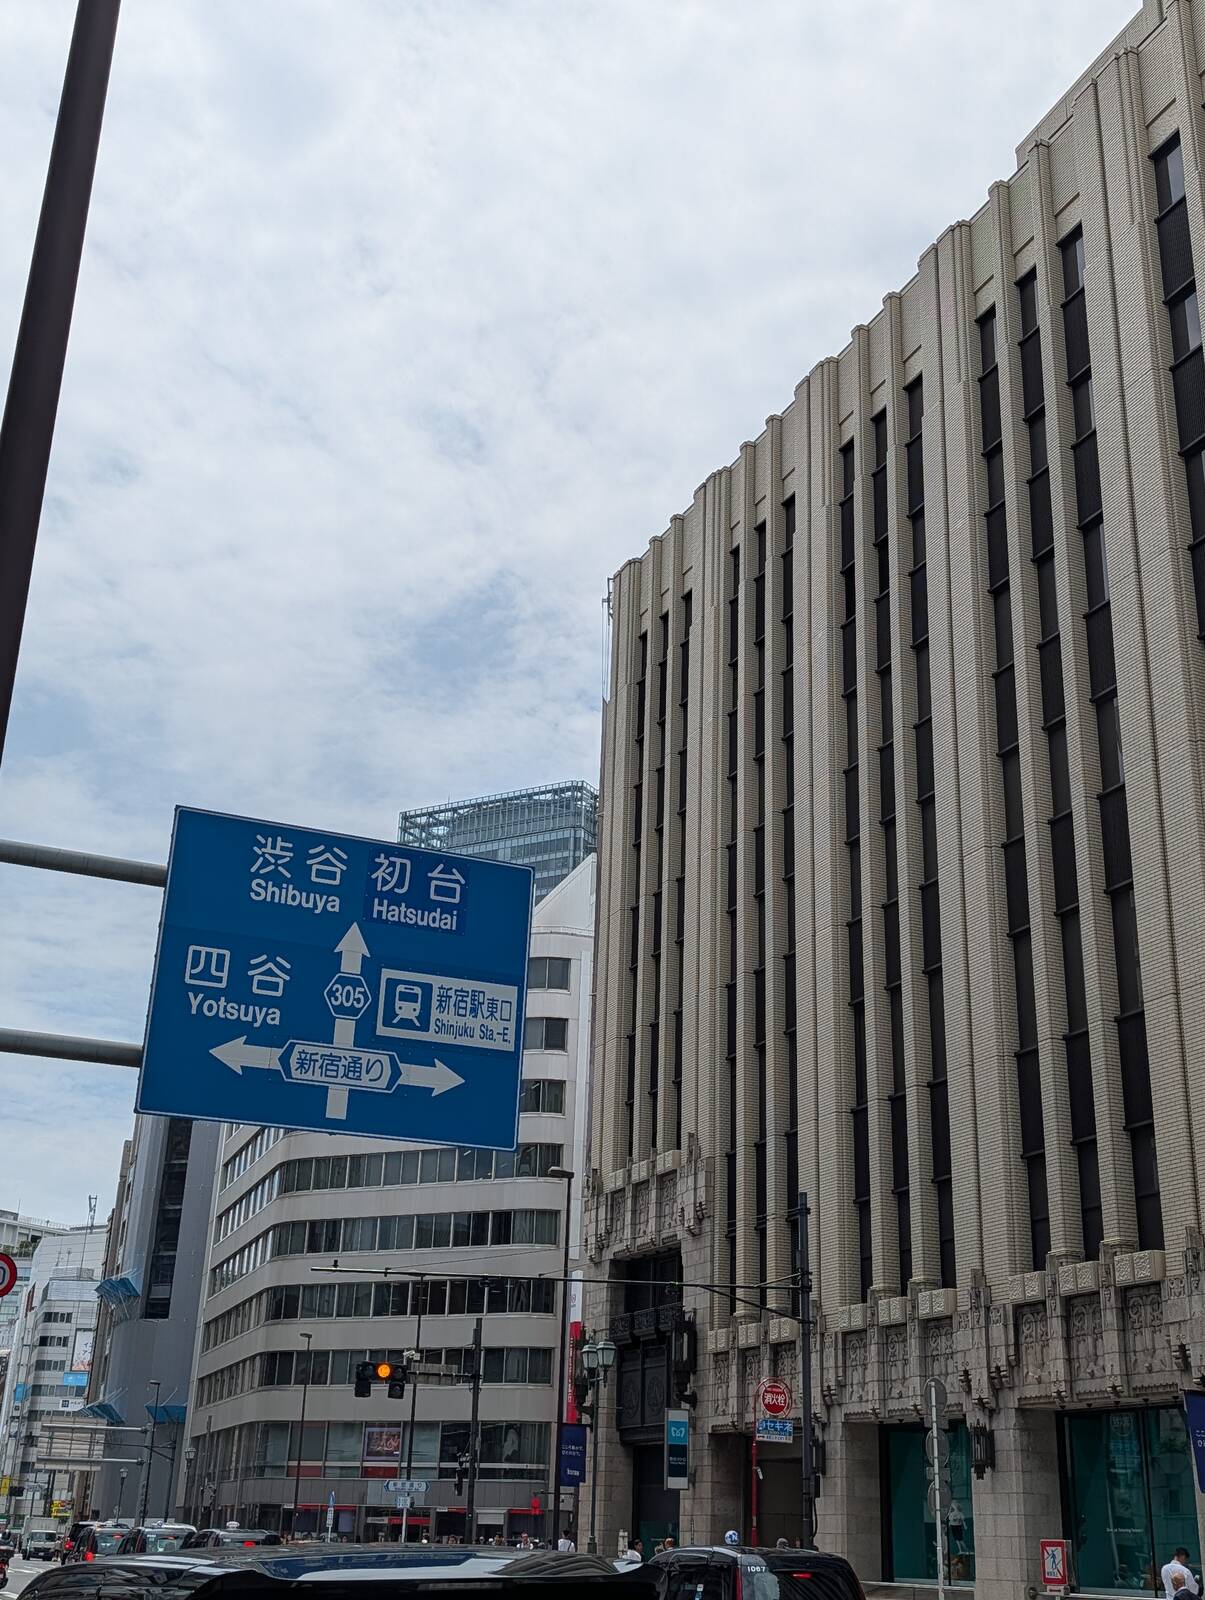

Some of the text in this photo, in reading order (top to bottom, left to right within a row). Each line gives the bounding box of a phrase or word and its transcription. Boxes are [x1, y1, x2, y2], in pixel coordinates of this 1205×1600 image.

[250, 834, 348, 886] 渋谷
[249, 878, 341, 914] Shibuya
[371, 853, 466, 904] 初台
[372, 897, 458, 931] Hatsudai
[184, 944, 292, 997] 四谷
[187, 991, 281, 1028] Yotsuya
[330, 983, 365, 1009] 305
[435, 984, 513, 1022] 新宿駅東口
[434, 1017, 475, 1040] Shinjuku
[295, 1049, 384, 1082] 新宿通り
[764, 1391, 786, 1406] 消火栓
